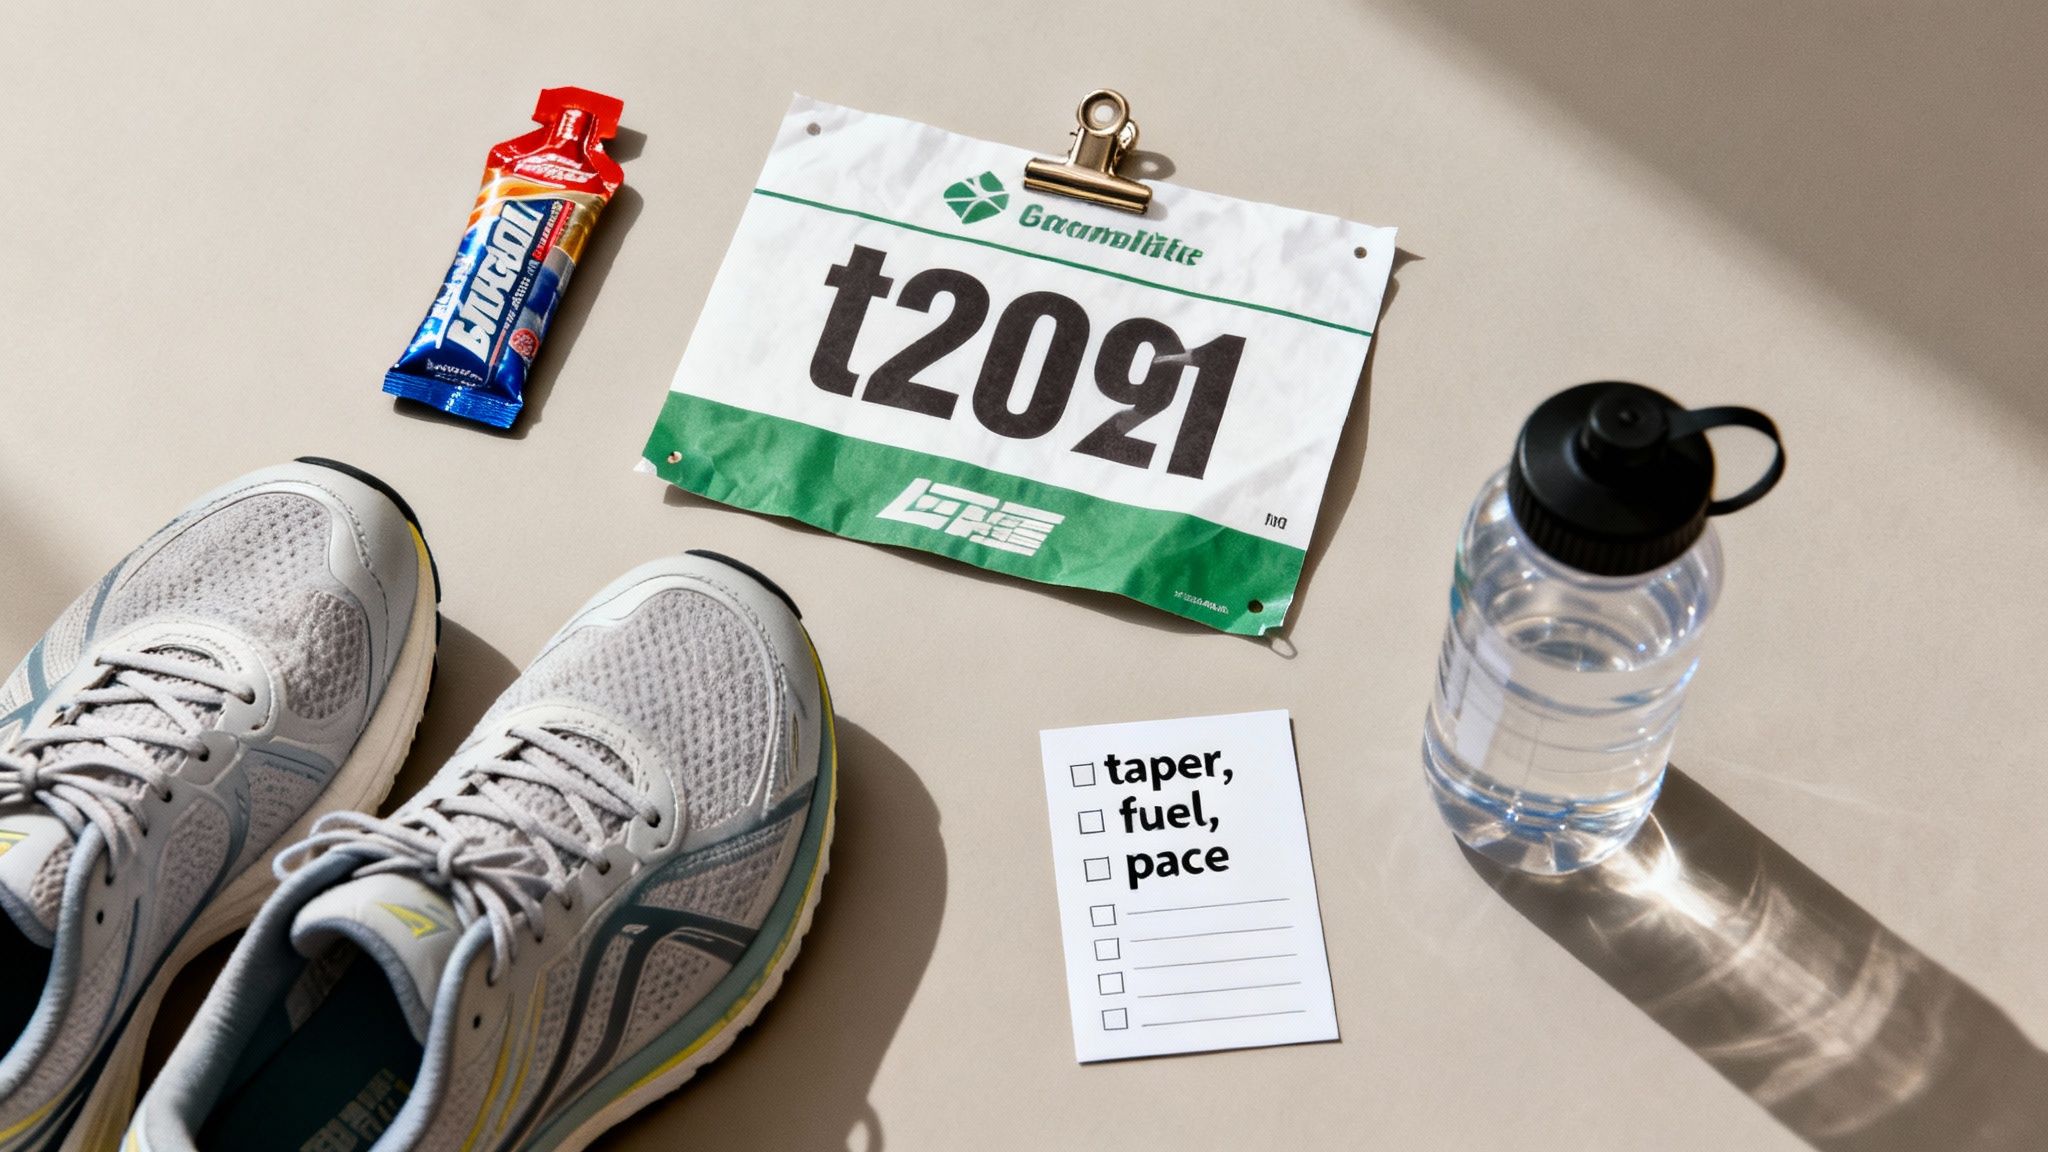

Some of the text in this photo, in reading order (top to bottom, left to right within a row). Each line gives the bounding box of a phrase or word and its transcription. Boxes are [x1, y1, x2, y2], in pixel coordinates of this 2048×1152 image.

[1104, 750, 1234, 791] taper,
[1119, 790, 1220, 833] fuel,
[1126, 846, 1230, 890] pace
